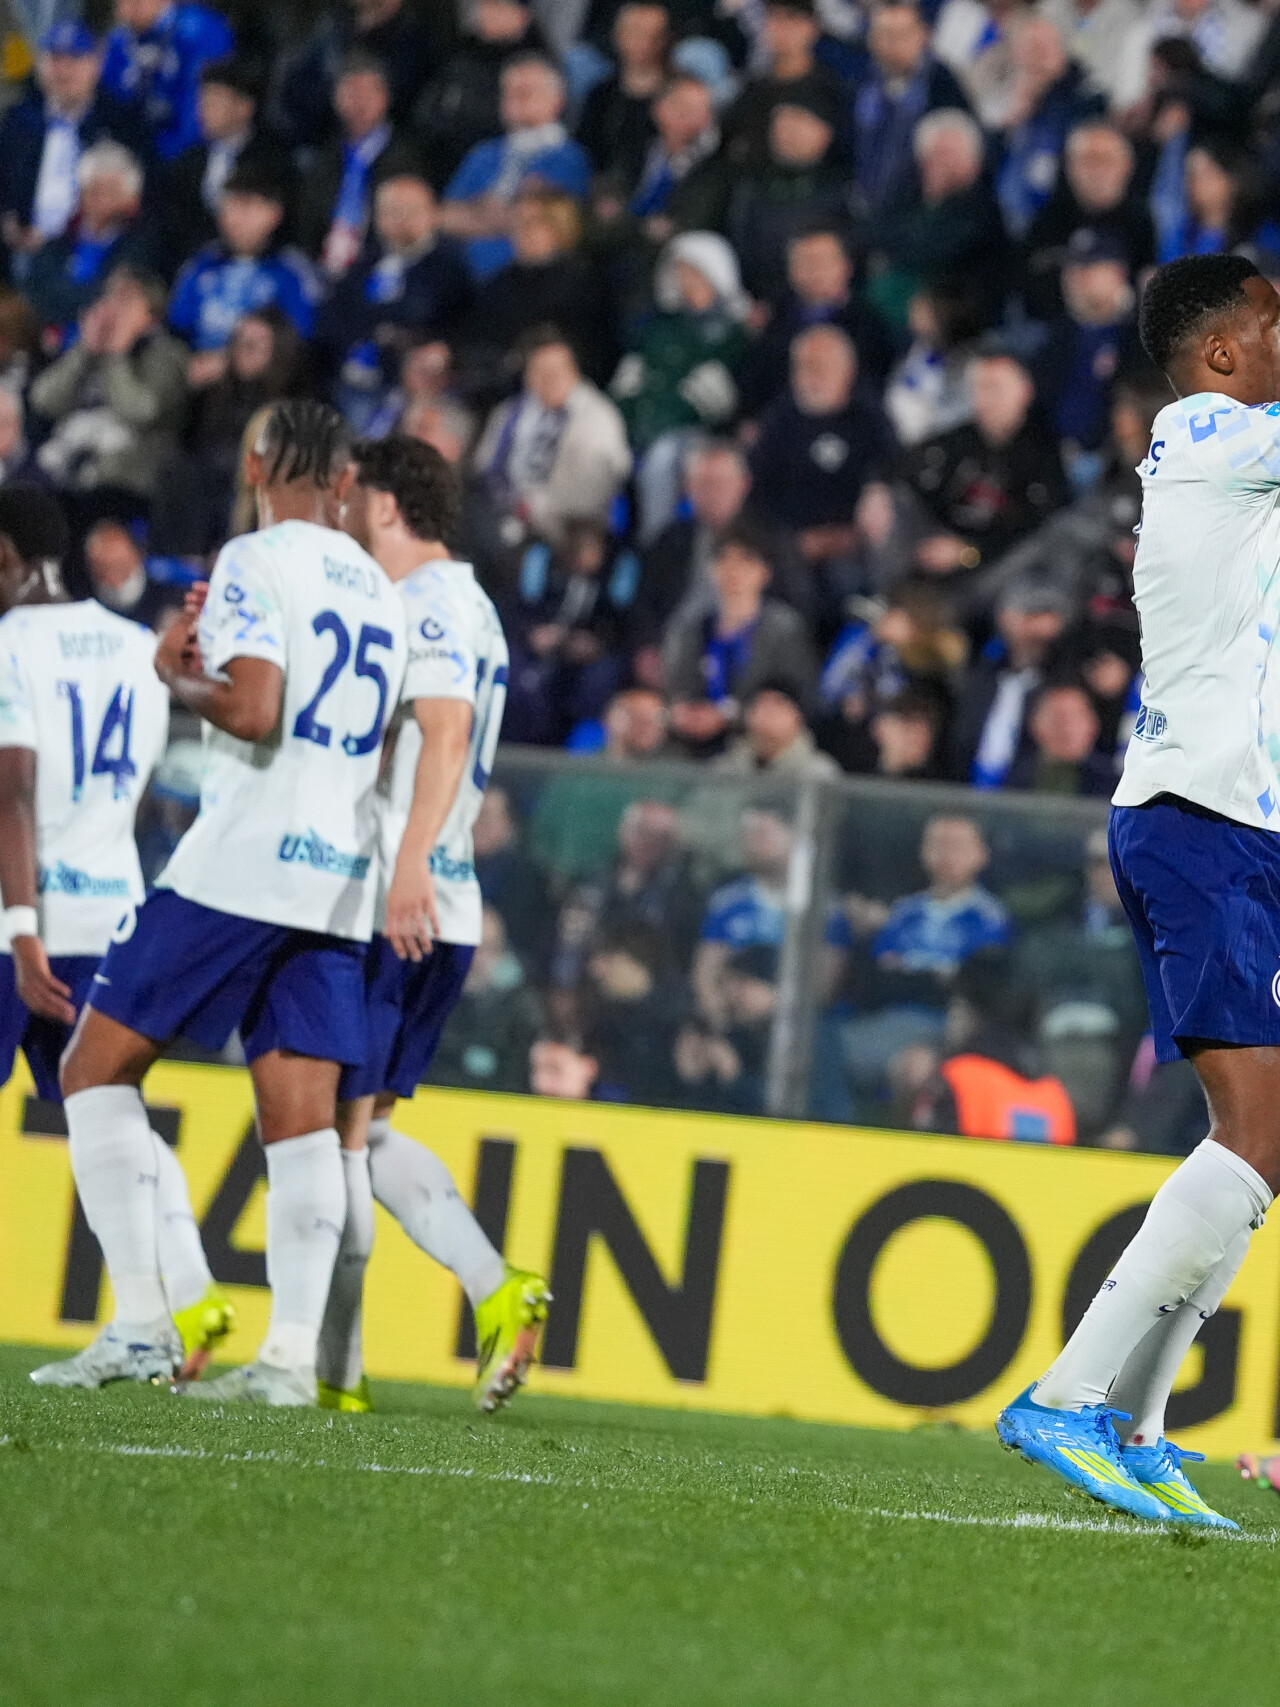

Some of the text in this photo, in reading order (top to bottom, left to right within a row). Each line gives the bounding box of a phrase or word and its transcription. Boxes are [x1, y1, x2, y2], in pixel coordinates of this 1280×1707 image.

[57, 679, 137, 803] 14
[293, 609, 393, 757] 25
[454, 1137, 732, 1385] IN
